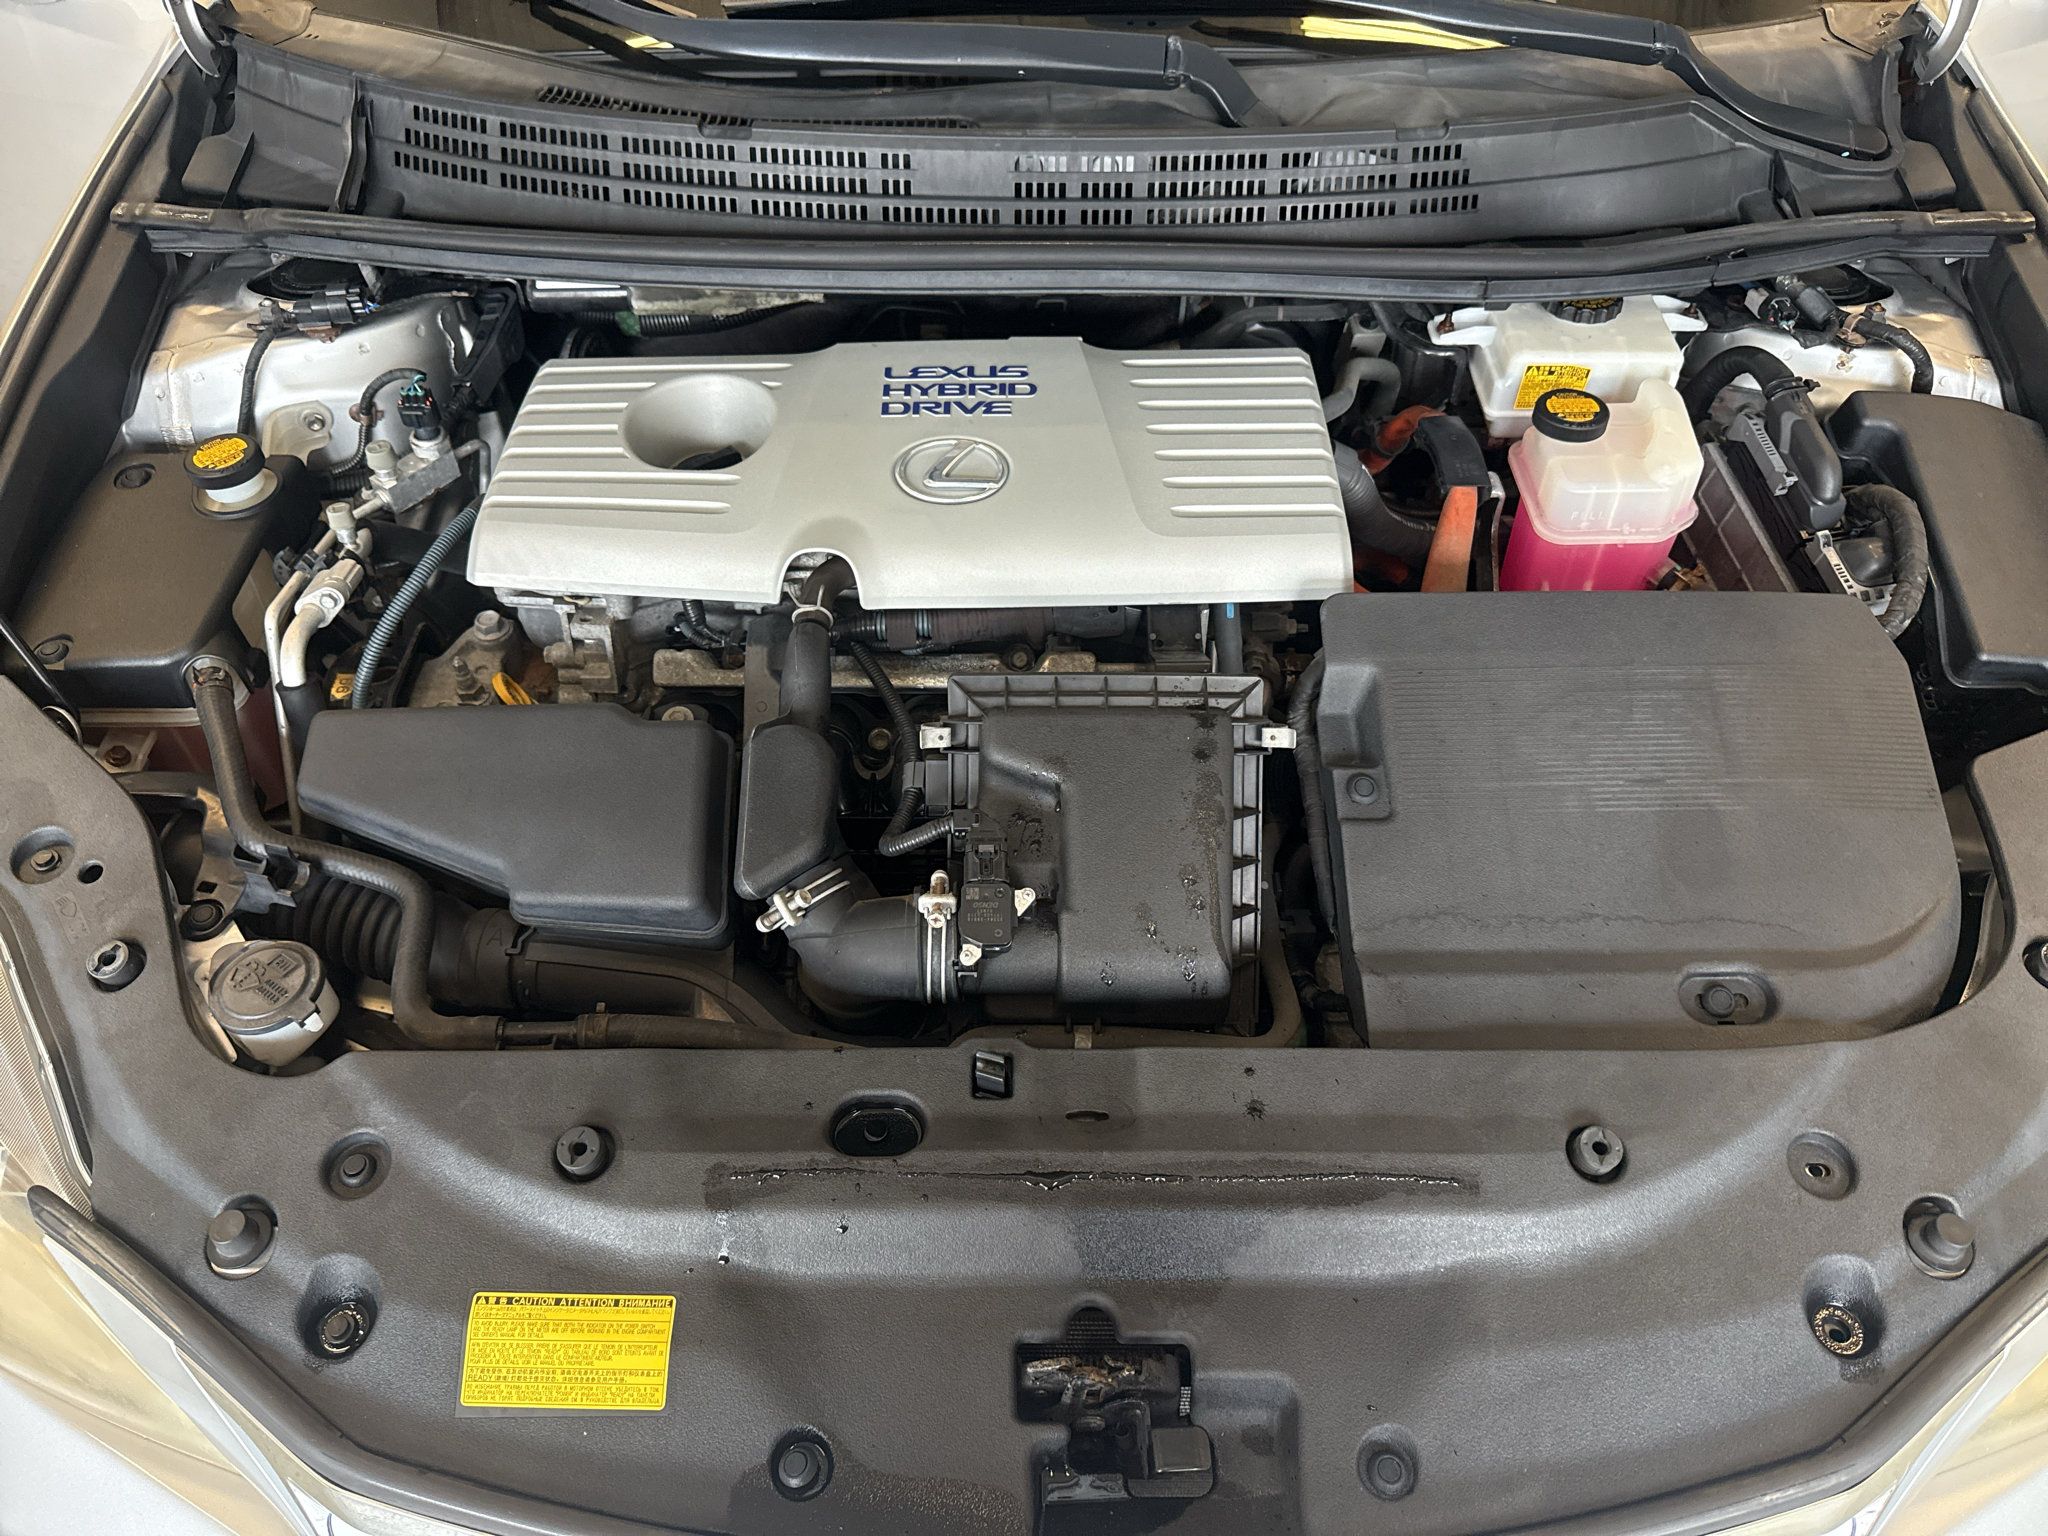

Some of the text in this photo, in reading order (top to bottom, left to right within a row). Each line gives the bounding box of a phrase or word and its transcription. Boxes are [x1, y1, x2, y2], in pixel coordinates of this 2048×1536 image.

[884, 365, 1029, 379] LEXUS
[882, 383, 1038, 398] HYBRID
[881, 400, 1013, 416] DRIVE
[512, 1297, 555, 1305] CAUTION
[560, 1298, 615, 1306] ATTENTION
[619, 1299, 671, 1307] ВНИМАНИЕ
